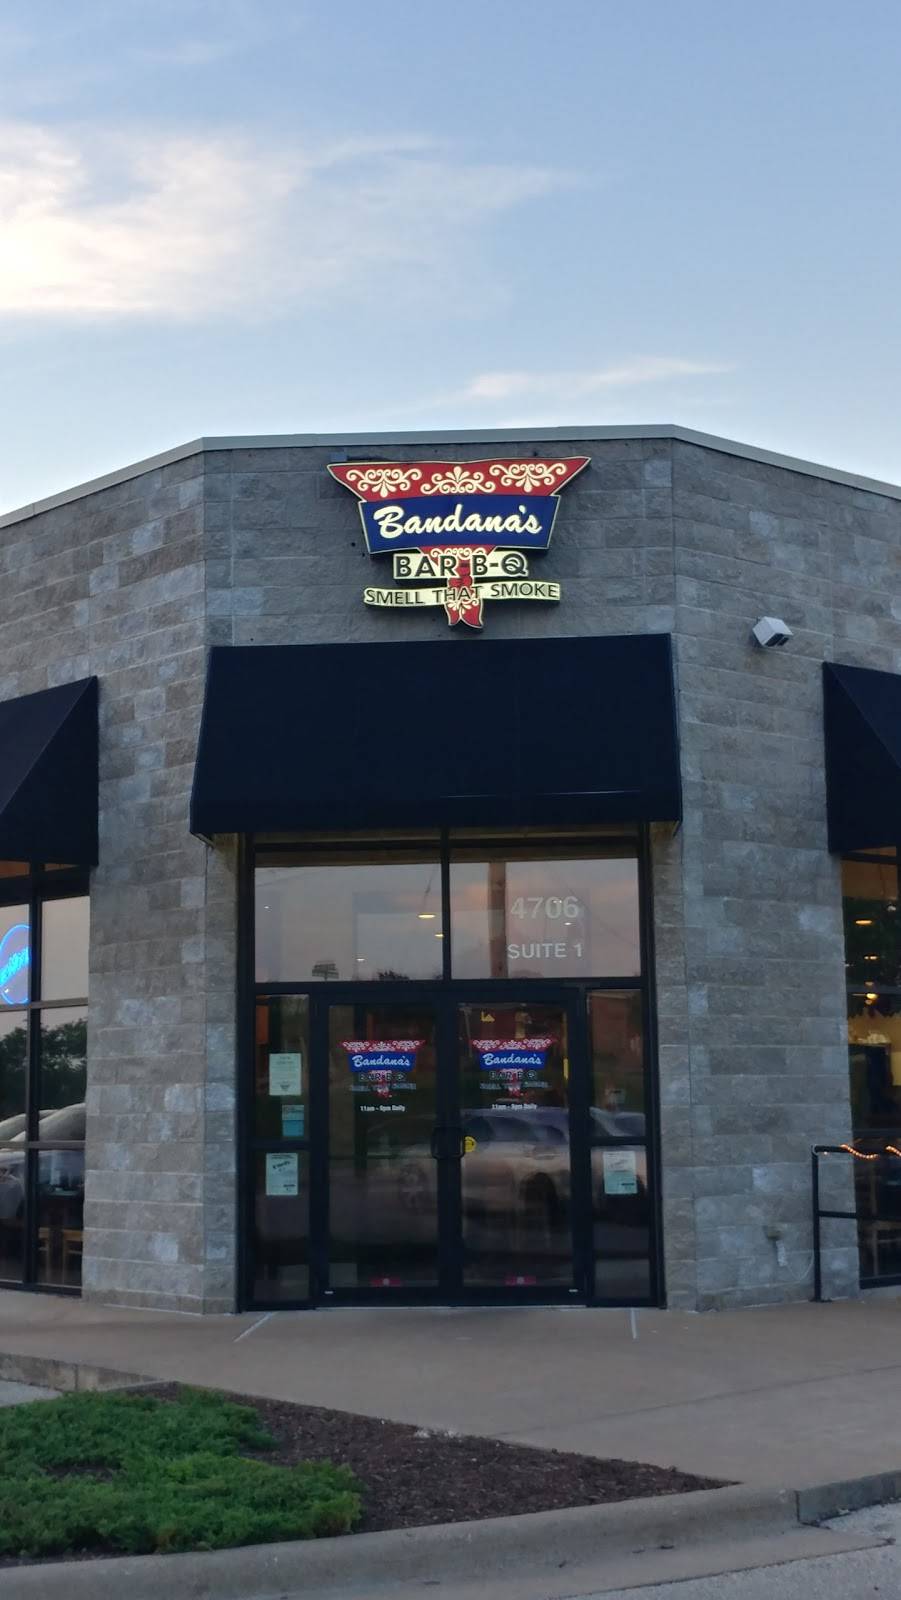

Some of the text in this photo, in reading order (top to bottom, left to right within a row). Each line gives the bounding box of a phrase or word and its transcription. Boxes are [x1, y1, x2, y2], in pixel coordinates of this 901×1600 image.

[373, 504, 542, 539] Bandana's
[366, 583, 559, 605] SMELL THAT SMOKE
[510, 896, 579, 919] 4706
[507, 942, 583, 959] SUITE 1
[351, 1055, 411, 1068] Bandana's
[482, 1053, 542, 1066] Bandana's
